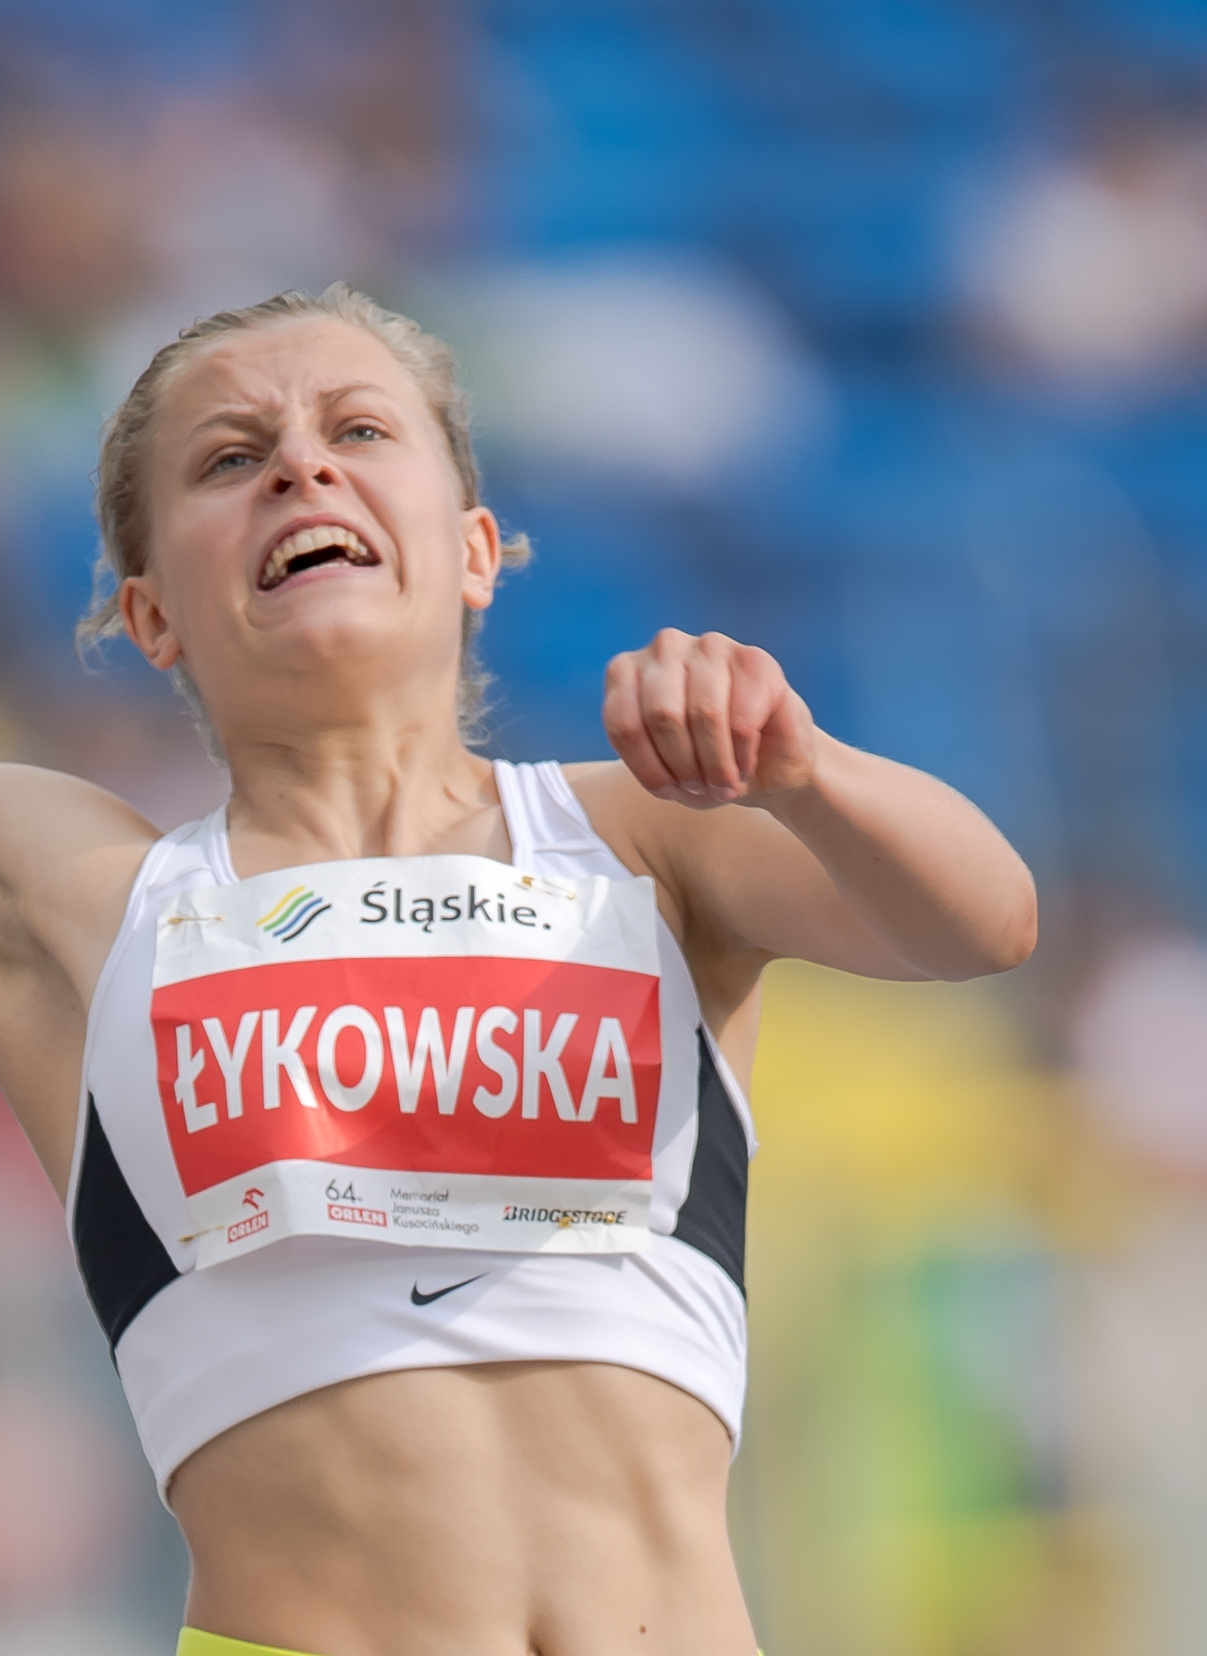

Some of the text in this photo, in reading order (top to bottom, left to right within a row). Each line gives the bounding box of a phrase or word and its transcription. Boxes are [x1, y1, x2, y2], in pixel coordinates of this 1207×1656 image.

[360, 881, 551, 932] Śląskie.
[174, 1004, 639, 1135] ŁYKOWSKA
[325, 1178, 363, 1203] 64.
[389, 1187, 449, 1202] Memoriał
[329, 1206, 385, 1226] ORLEN
[392, 1201, 440, 1217] Janusza
[229, 1213, 268, 1241] ORLEN
[392, 1215, 479, 1235] Kusocińskiego
